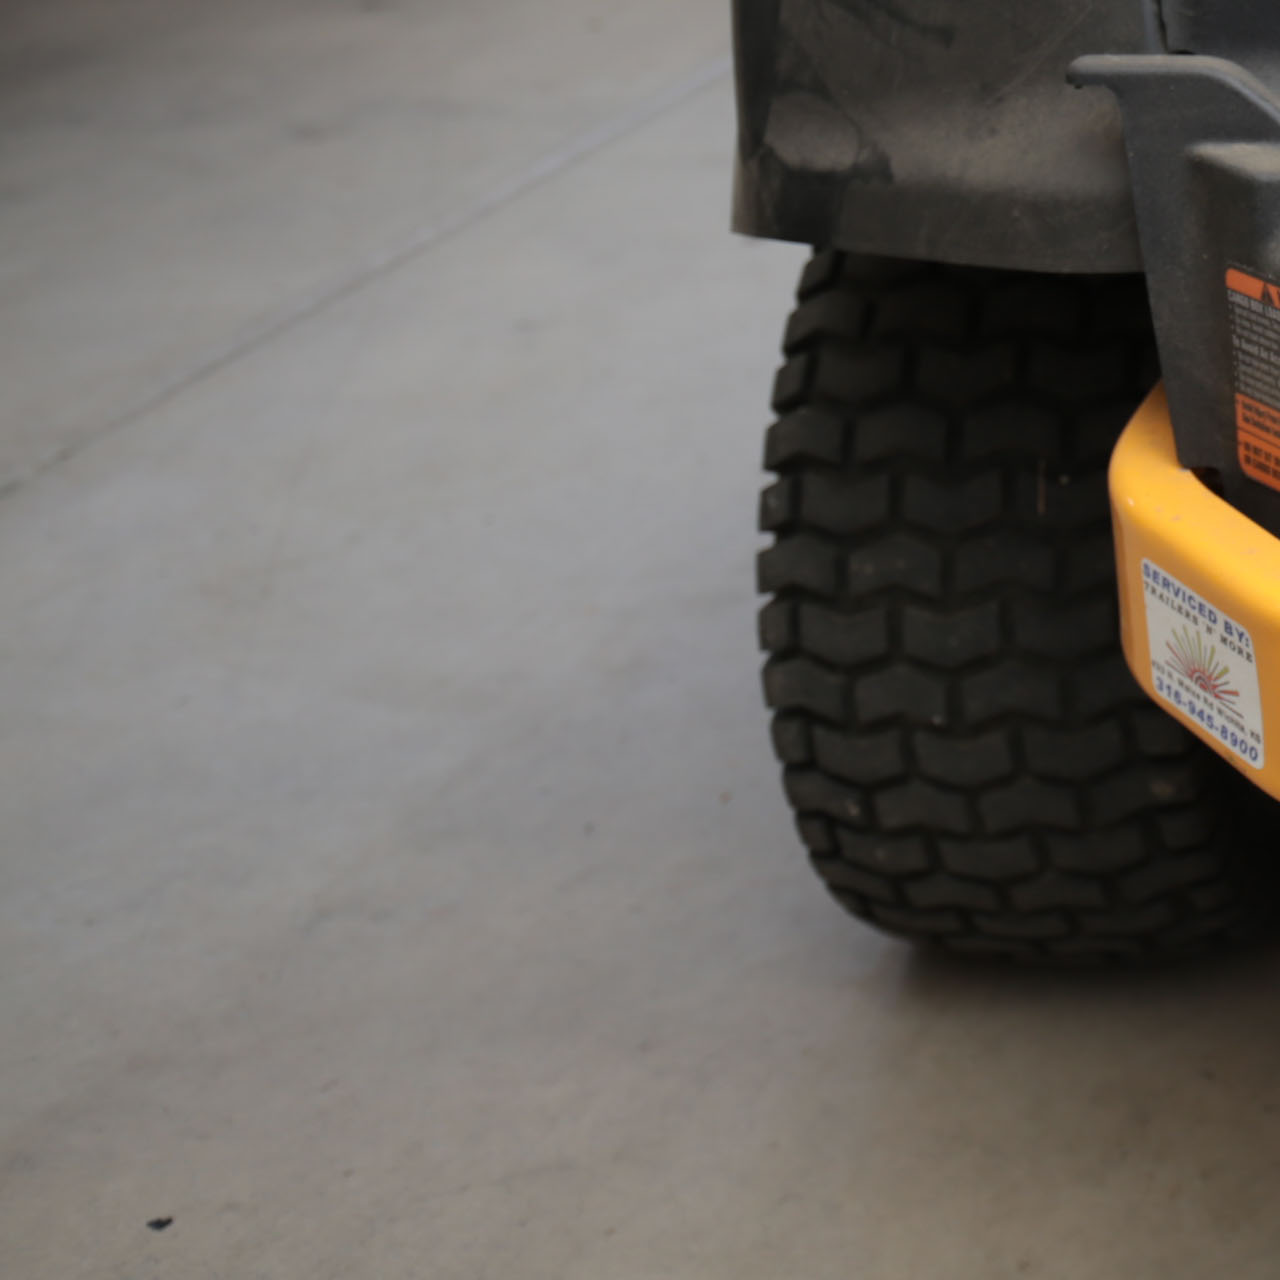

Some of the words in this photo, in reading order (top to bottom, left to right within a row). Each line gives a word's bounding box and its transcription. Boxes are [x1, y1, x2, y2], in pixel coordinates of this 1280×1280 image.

[1143, 561, 1217, 626] SERVICED
[1223, 618, 1249, 648] BY:
[1143, 579, 1198, 627] TRAILERS
[1219, 632, 1253, 664] MORE
[1155, 674, 1258, 764] 316-945-8900
